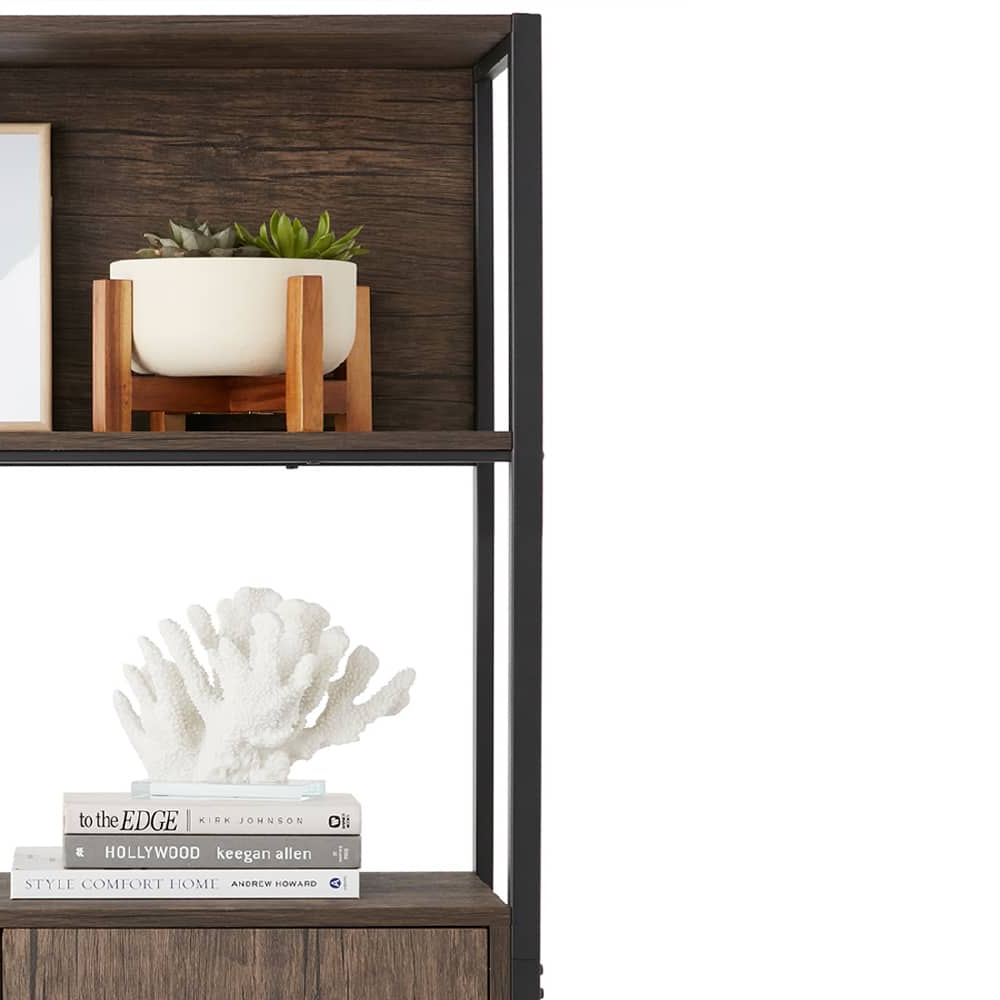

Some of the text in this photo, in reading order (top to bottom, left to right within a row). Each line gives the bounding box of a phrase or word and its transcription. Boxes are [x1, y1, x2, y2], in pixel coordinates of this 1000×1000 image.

[79, 809, 179, 832] to the EDGE
[199, 816, 304, 825] KIRK JOHNSON
[104, 845, 201, 860] HOLLYWOOD
[216, 846, 312, 864] keegan allen
[24, 878, 220, 890] STYLE COMFORT HOME
[231, 880, 318, 888] ANDREW HOWARD
